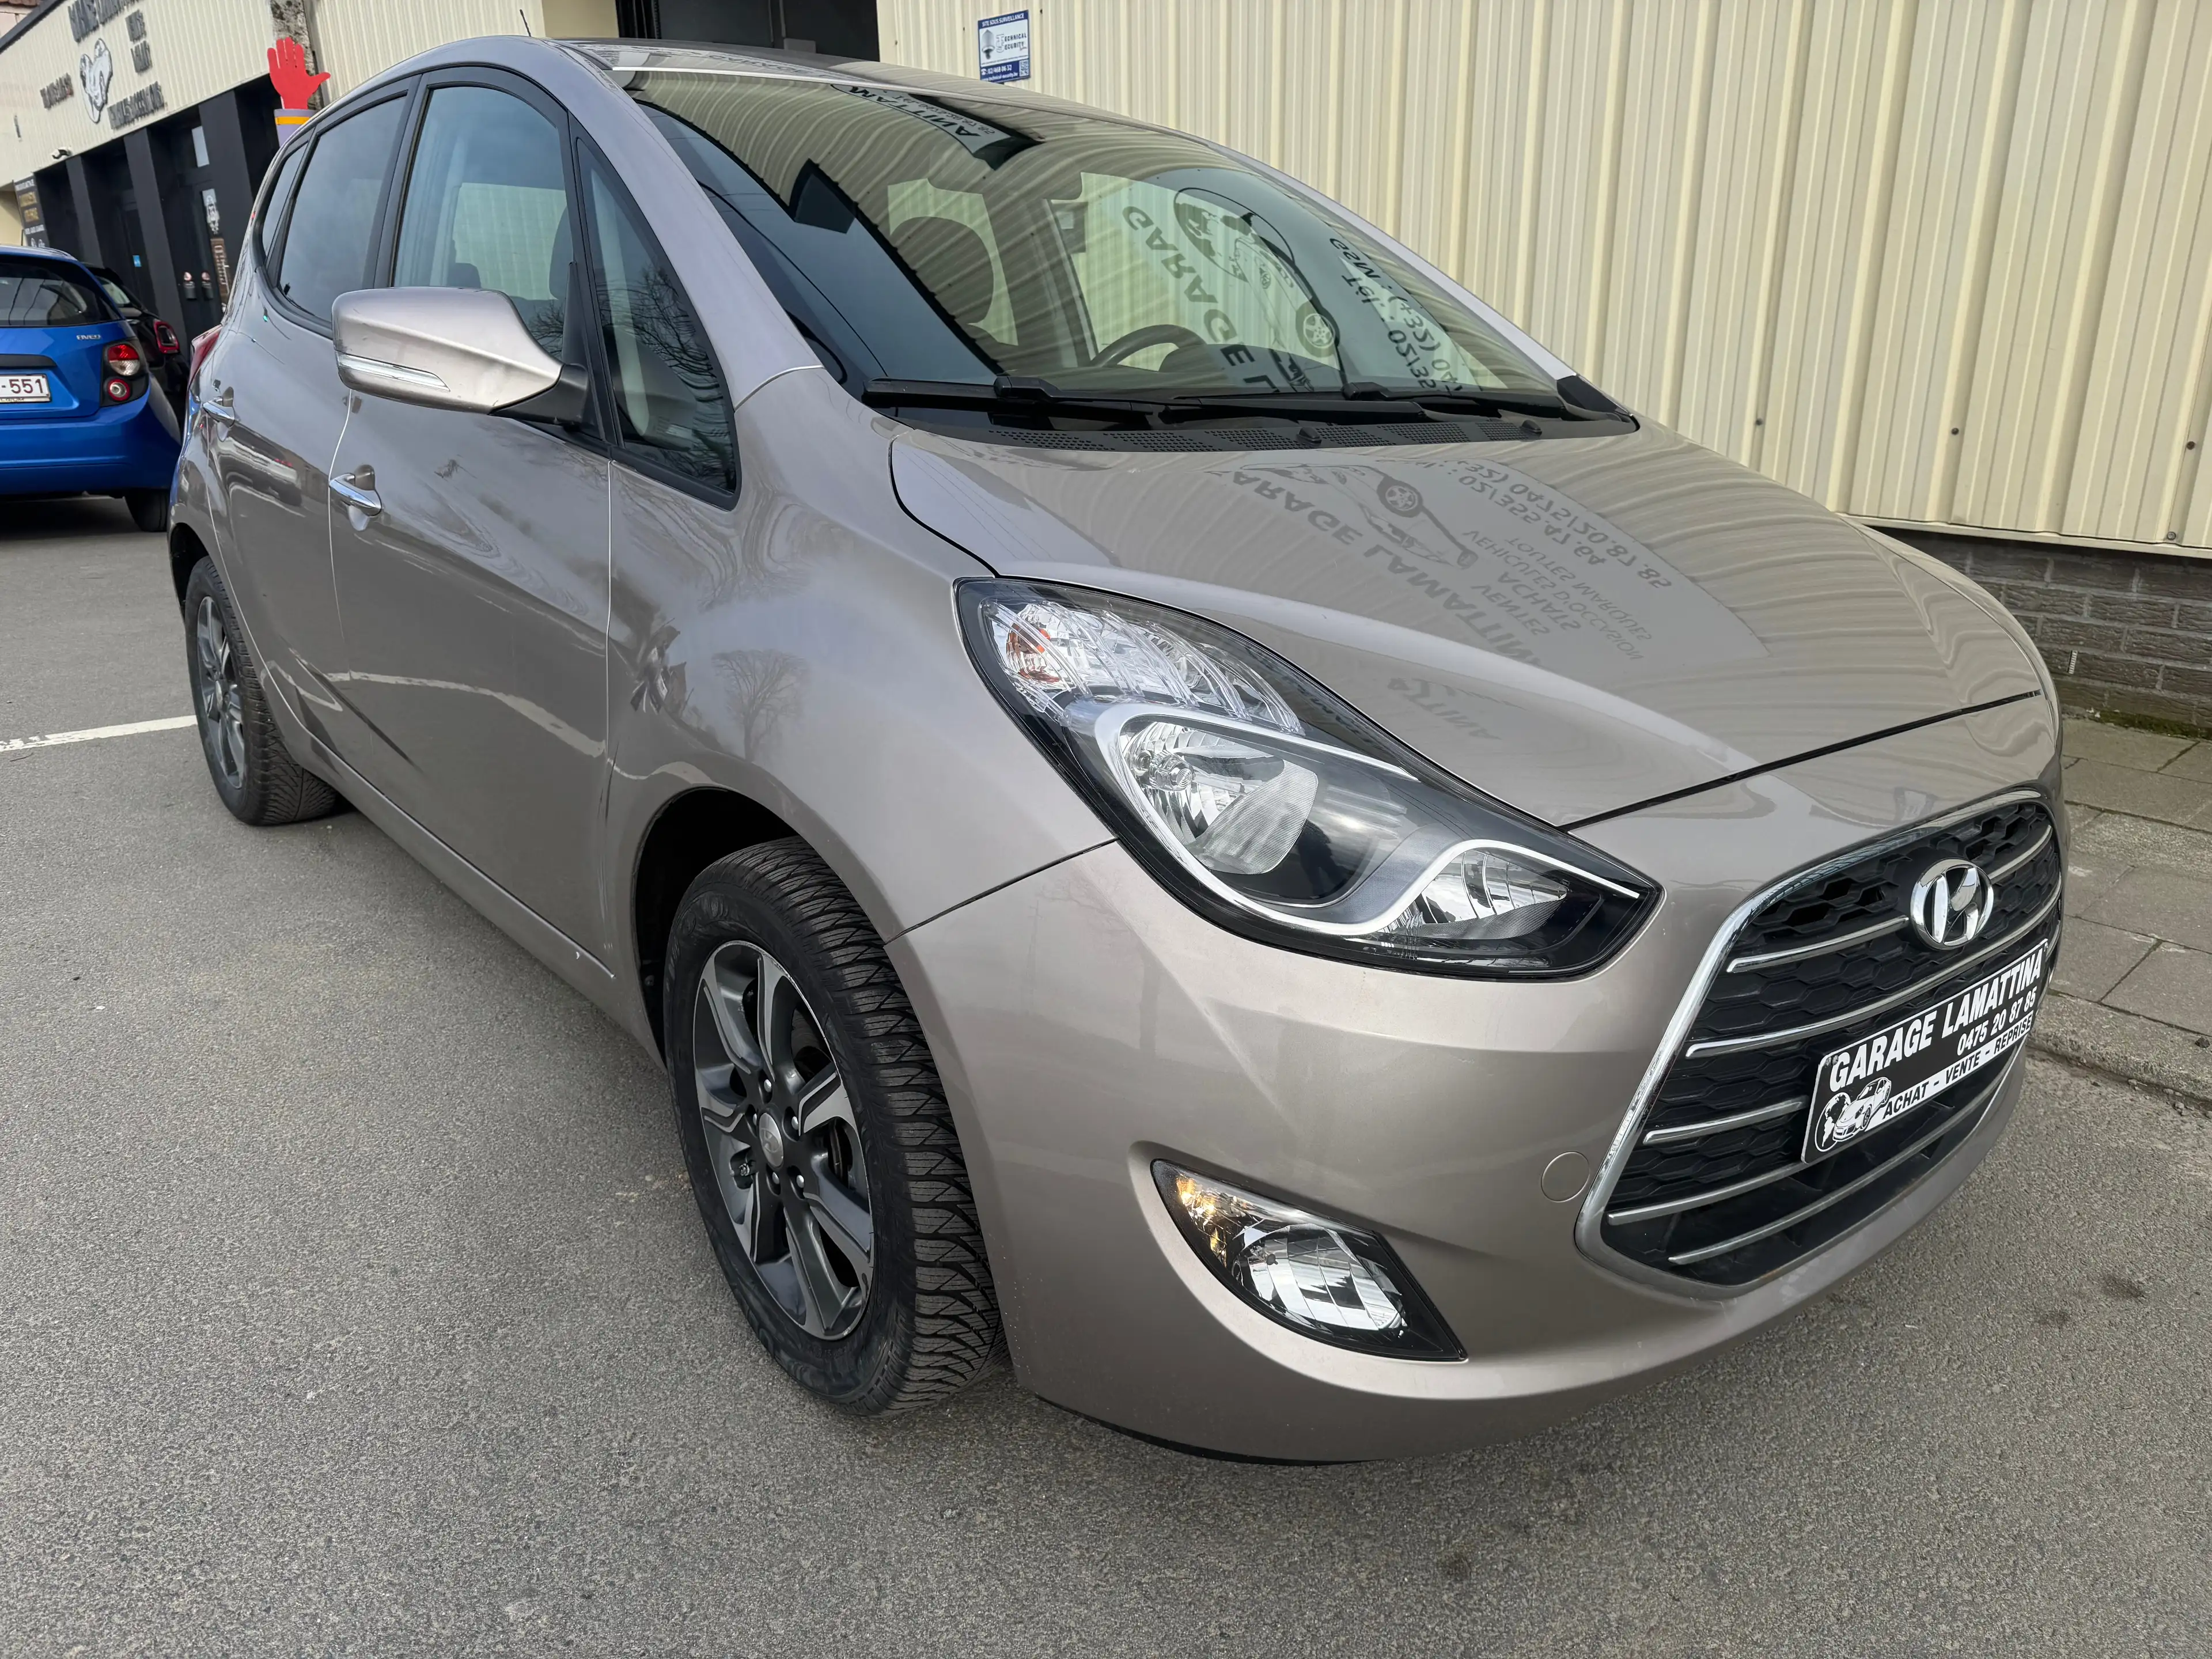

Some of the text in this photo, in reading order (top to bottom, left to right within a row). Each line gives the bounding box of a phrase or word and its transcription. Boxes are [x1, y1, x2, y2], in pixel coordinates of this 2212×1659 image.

[999, 13, 1024, 24] SURVEILLANCE
[1830, 948, 2043, 1092] GARAGE LAMATTINA
[1957, 986, 2037, 1056] 0475 20 87 85
[1883, 1081, 1929, 1119] ACHAT
[1945, 1050, 1982, 1084] VENTE
[1994, 1013, 2033, 1055] REPRISE
